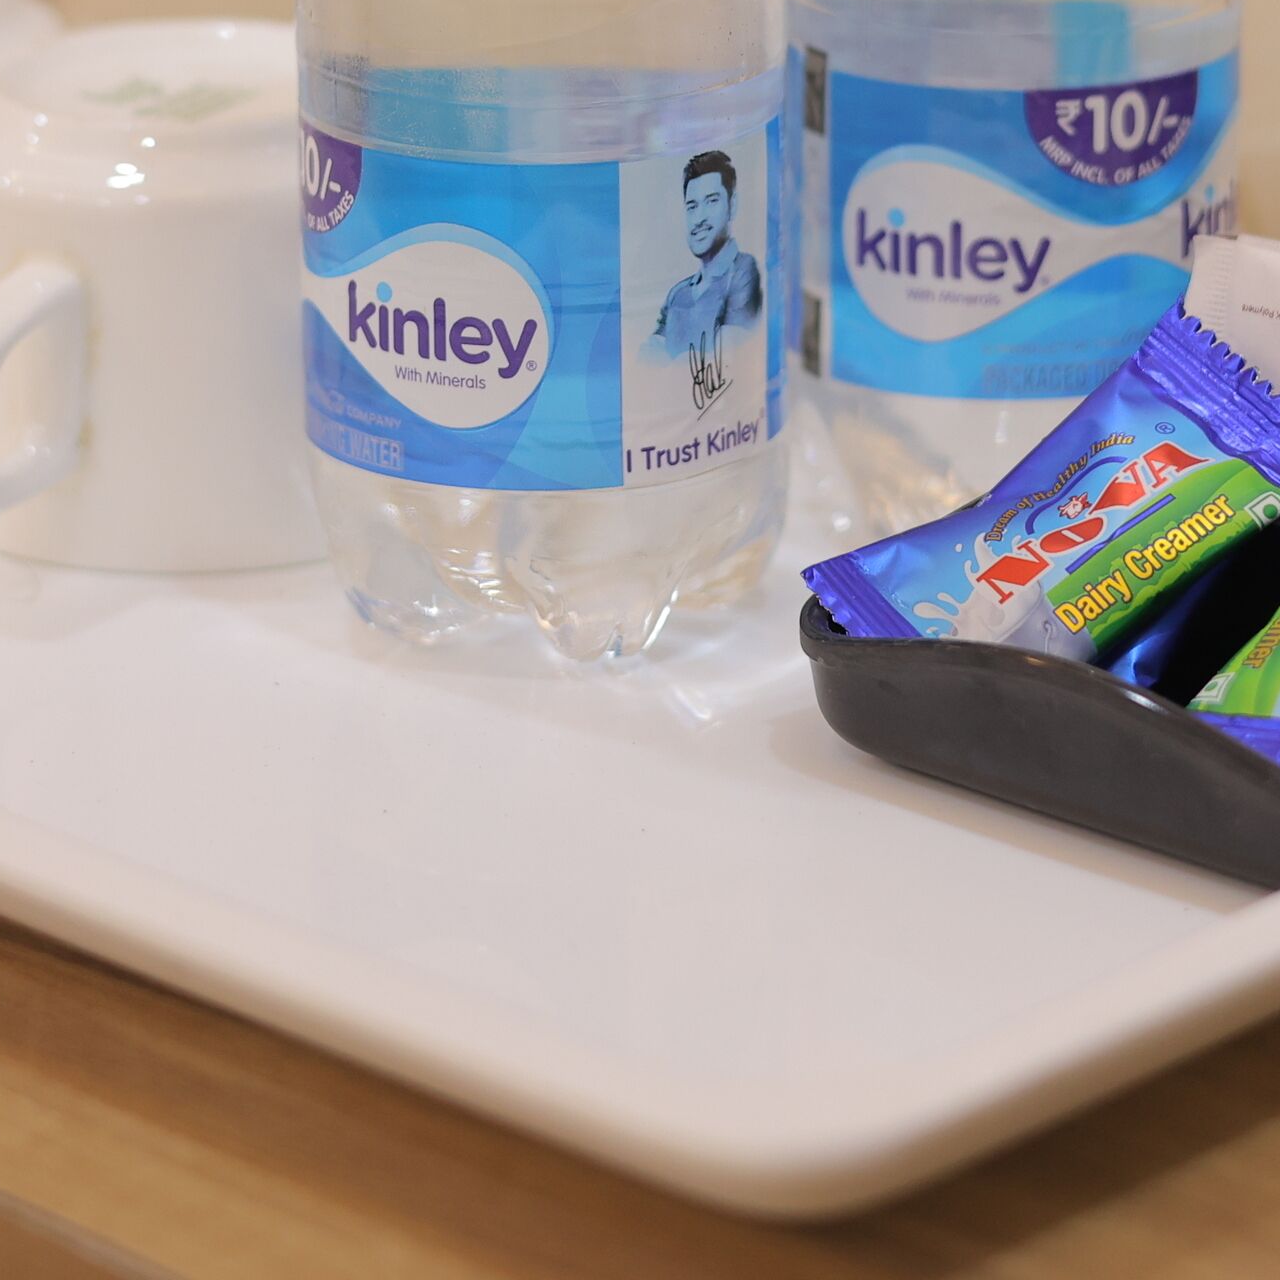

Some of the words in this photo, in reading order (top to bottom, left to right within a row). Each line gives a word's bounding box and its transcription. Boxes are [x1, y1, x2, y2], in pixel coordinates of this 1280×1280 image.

[1039, 135, 1071, 167] MRP
[1113, 166, 1135, 185] OF
[1138, 155, 1163, 179] ALL
[317, 215, 330, 232] ALL
[328, 190, 355, 226] TAXES
[855, 207, 1051, 293] kinley
[347, 279, 537, 379] kinley
[395, 365, 423, 385] With
[425, 370, 487, 390] Minerals
[351, 430, 404, 468] WATER
[626, 449, 632, 473] I
[641, 437, 700, 470] Trust
[707, 419, 759, 456] Kinley
[984, 507, 1018, 542] Dream
[1017, 497, 1034, 512] of
[1032, 455, 1089, 502] Healthy
[1088, 432, 1135, 458] India
[977, 442, 1210, 604] NOVA
[1053, 569, 1133, 634] Dairy
[1123, 493, 1237, 580] Creamer
